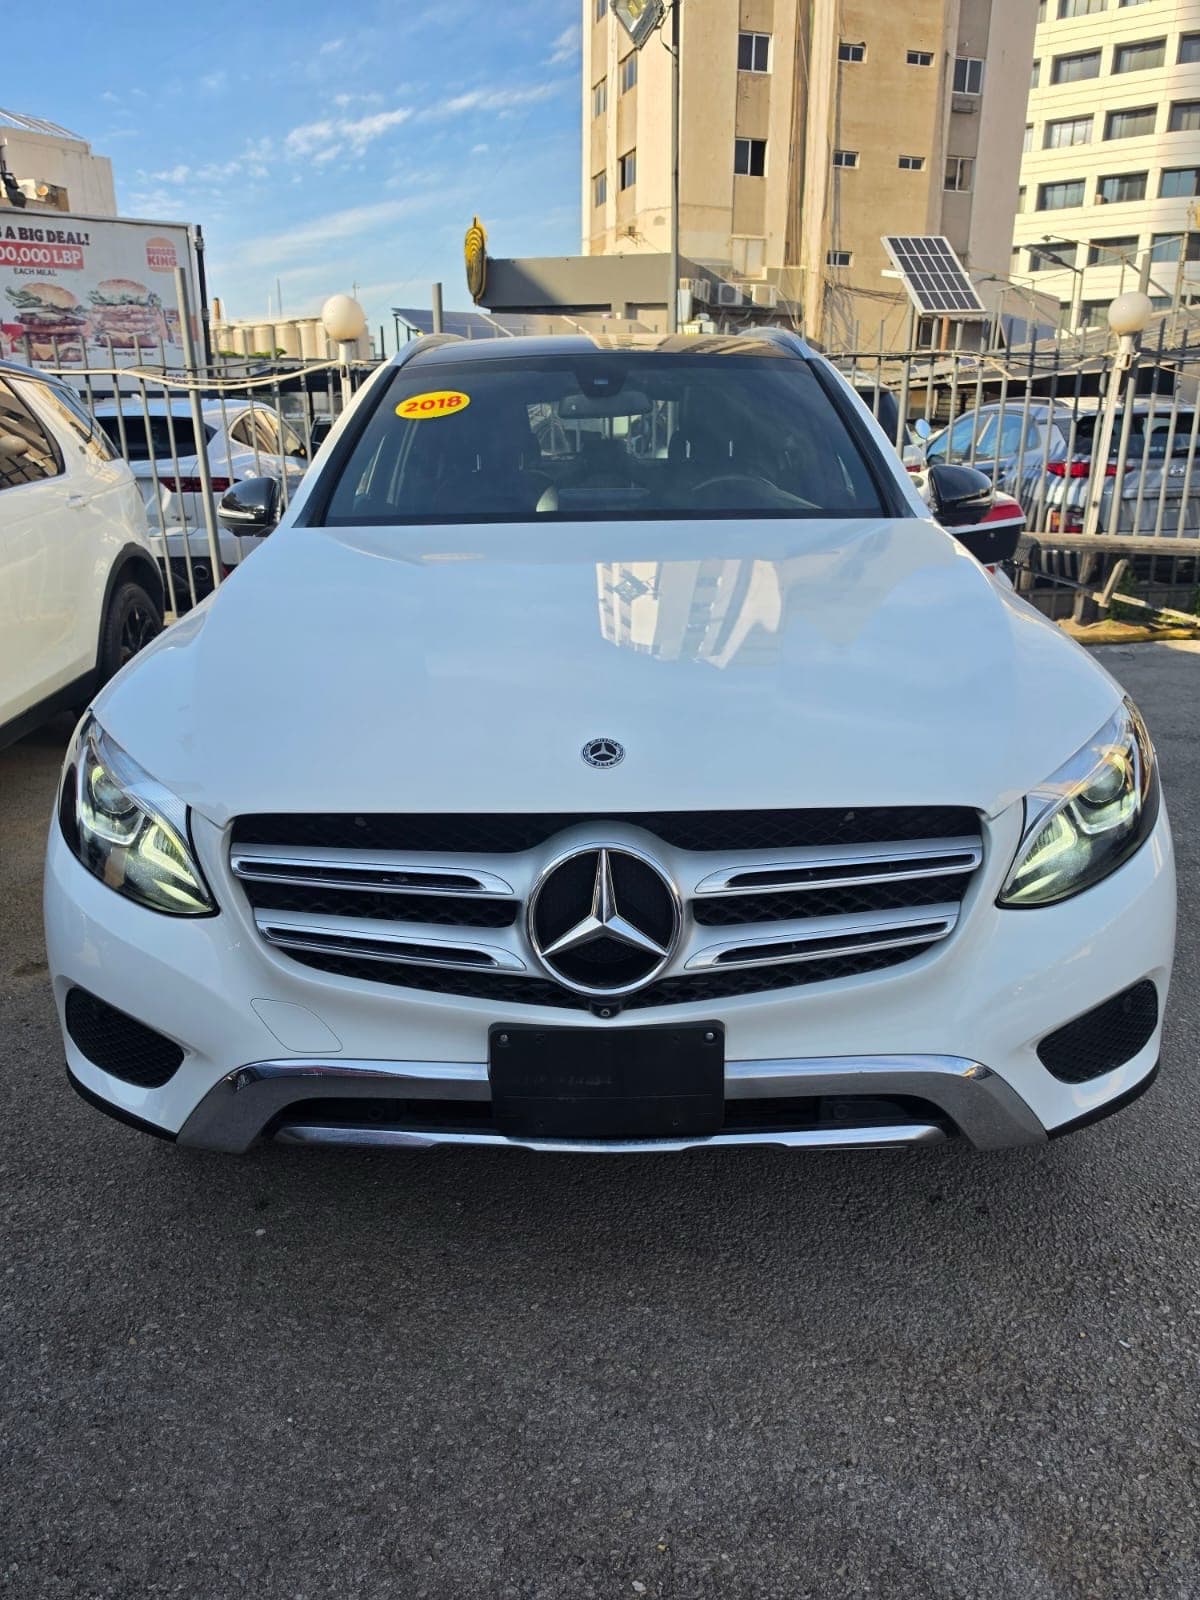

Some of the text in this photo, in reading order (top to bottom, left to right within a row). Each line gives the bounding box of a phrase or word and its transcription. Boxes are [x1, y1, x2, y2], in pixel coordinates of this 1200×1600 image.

[5, 226, 16, 239] A
[18, 227, 44, 242] BIG
[46, 229, 90, 246] DEAL!
[52, 250, 81, 265] LBP
[147, 255, 177, 266] KING
[404, 395, 462, 413] 2018
